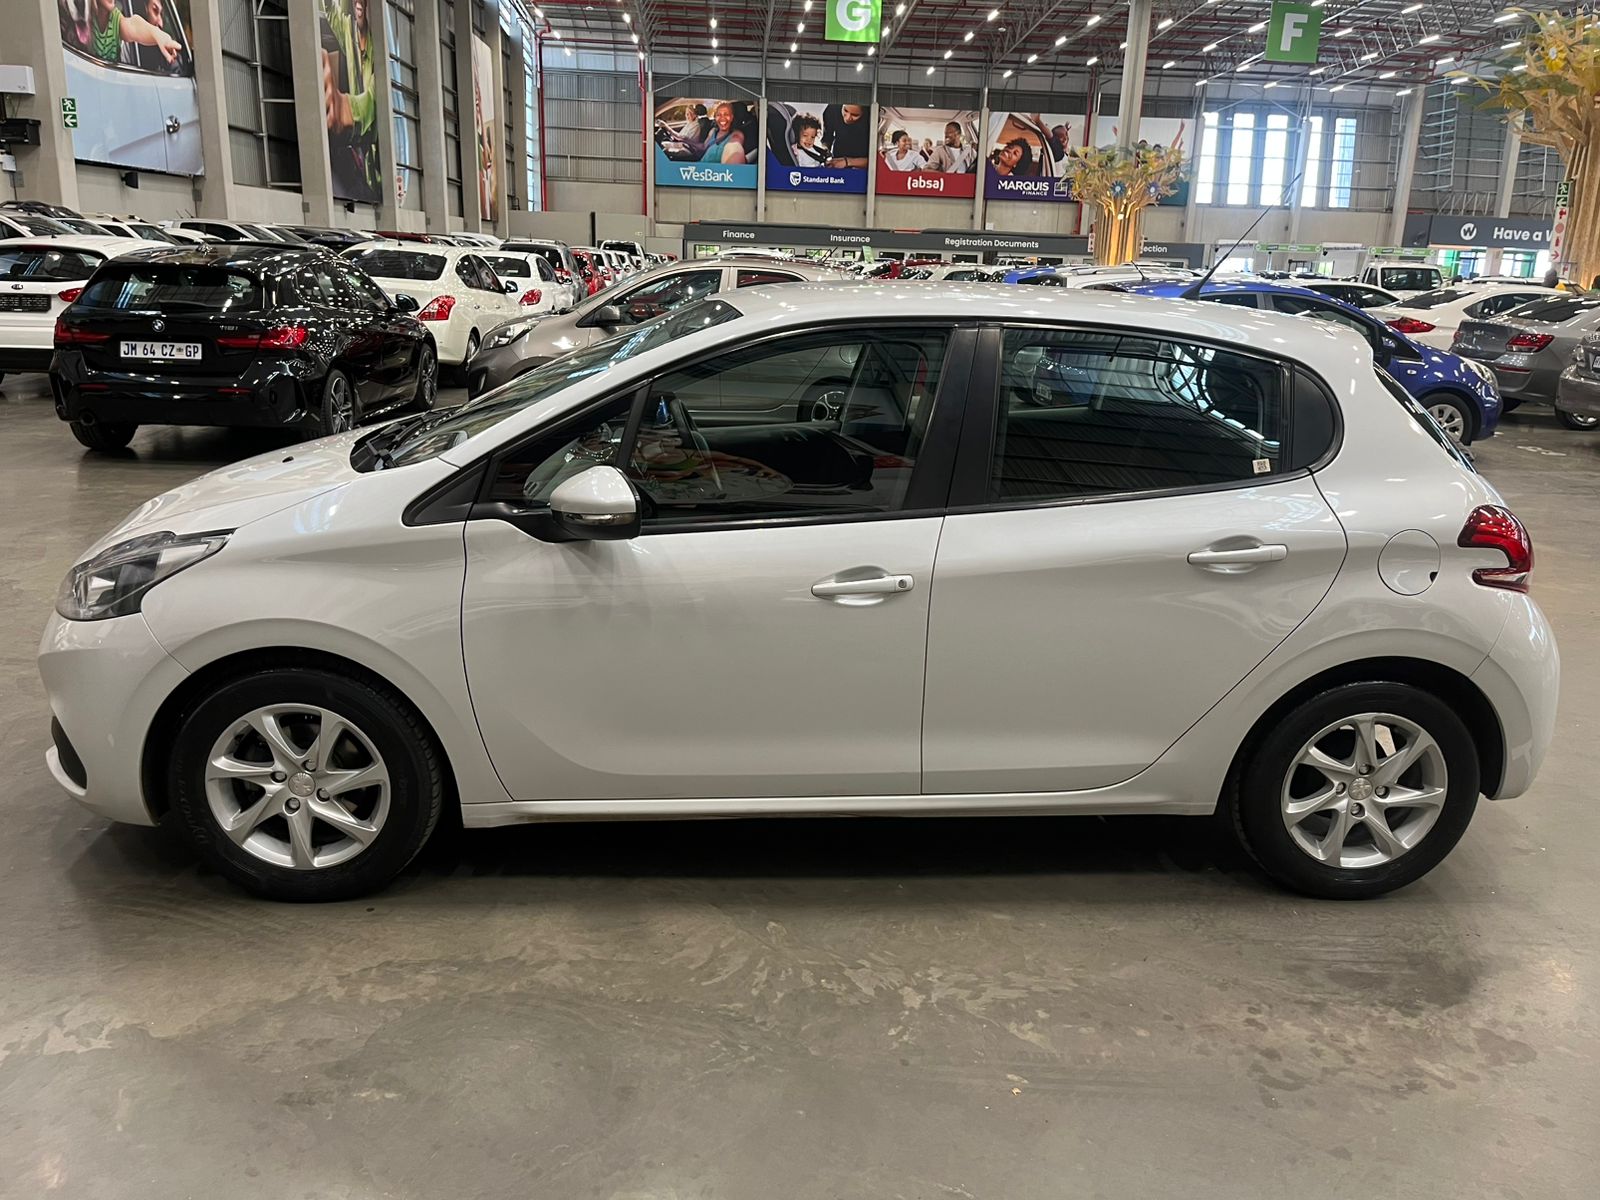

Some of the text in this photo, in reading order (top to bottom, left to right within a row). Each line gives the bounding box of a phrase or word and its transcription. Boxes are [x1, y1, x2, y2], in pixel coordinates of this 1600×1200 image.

[836, 0, 871, 31] G
[1280, 13, 1308, 51] F
[679, 166, 733, 182] WesBank
[803, 176, 829, 184] Standard
[998, 180, 1049, 191] MARQUIS
[722, 230, 755, 239] Finance
[830, 234, 871, 243] Insurance
[1493, 227, 1530, 240] Have
[1532, 231, 1542, 241] a
[945, 238, 1039, 248] Registration Documents
[1143, 245, 1168, 253] ection
[123, 343, 199, 358] JM 64 CZ GP
